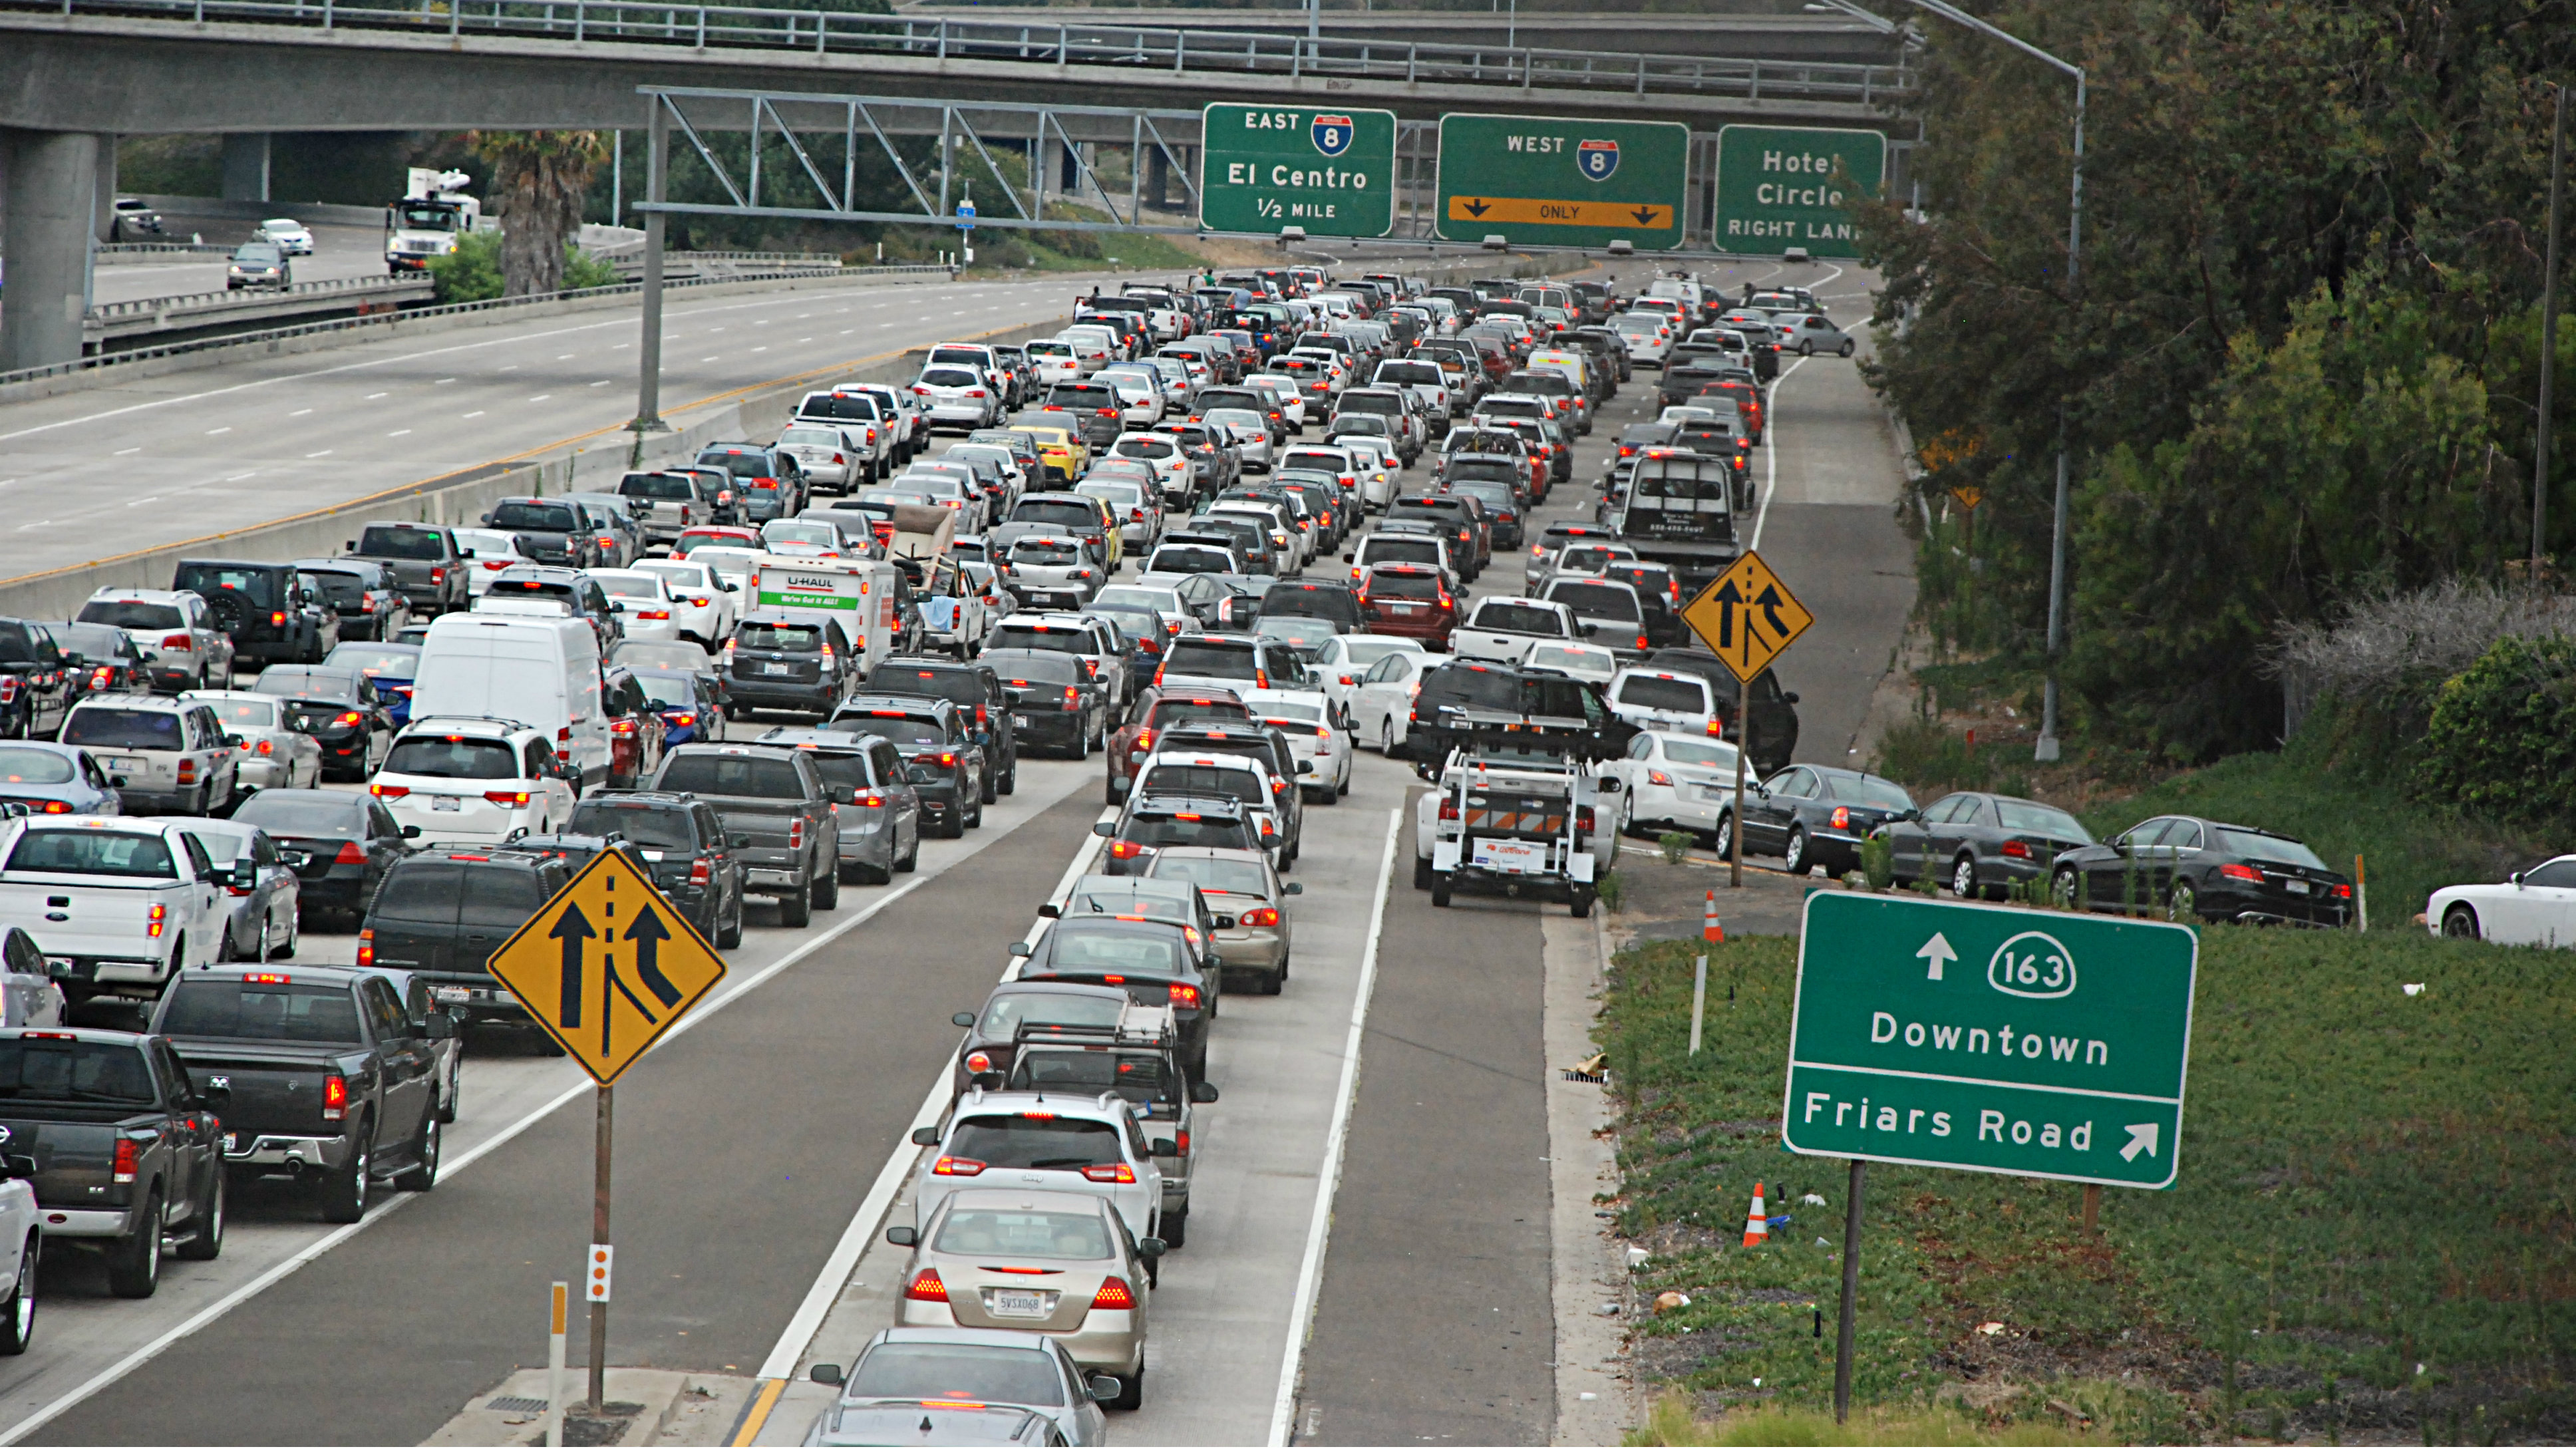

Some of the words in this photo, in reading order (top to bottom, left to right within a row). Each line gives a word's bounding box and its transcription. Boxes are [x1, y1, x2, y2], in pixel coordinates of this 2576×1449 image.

[1245, 112, 1299, 130] EAST
[1324, 127, 1339, 148] 8
[1507, 136, 1565, 153] WEST
[1590, 152, 1605, 172] 8
[1228, 163, 1255, 184] El
[1271, 165, 1367, 189] Centro
[1757, 183, 1843, 206] Circle
[1292, 204, 1335, 218] MILE
[1539, 204, 1580, 220] ONLY
[1728, 219, 1796, 238] RIGHT
[1807, 222, 1860, 240] LAN
[788, 577, 833, 587] U-HAUL
[2004, 951, 2064, 988] 163
[1870, 1011, 2109, 1066] Downtown
[1804, 1091, 1952, 1138] Friars
[1978, 1108, 2092, 1152] Road
[1023, 1173, 1043, 1182] Jeep
[1000, 1297, 1039, 1309] 5VSX068
